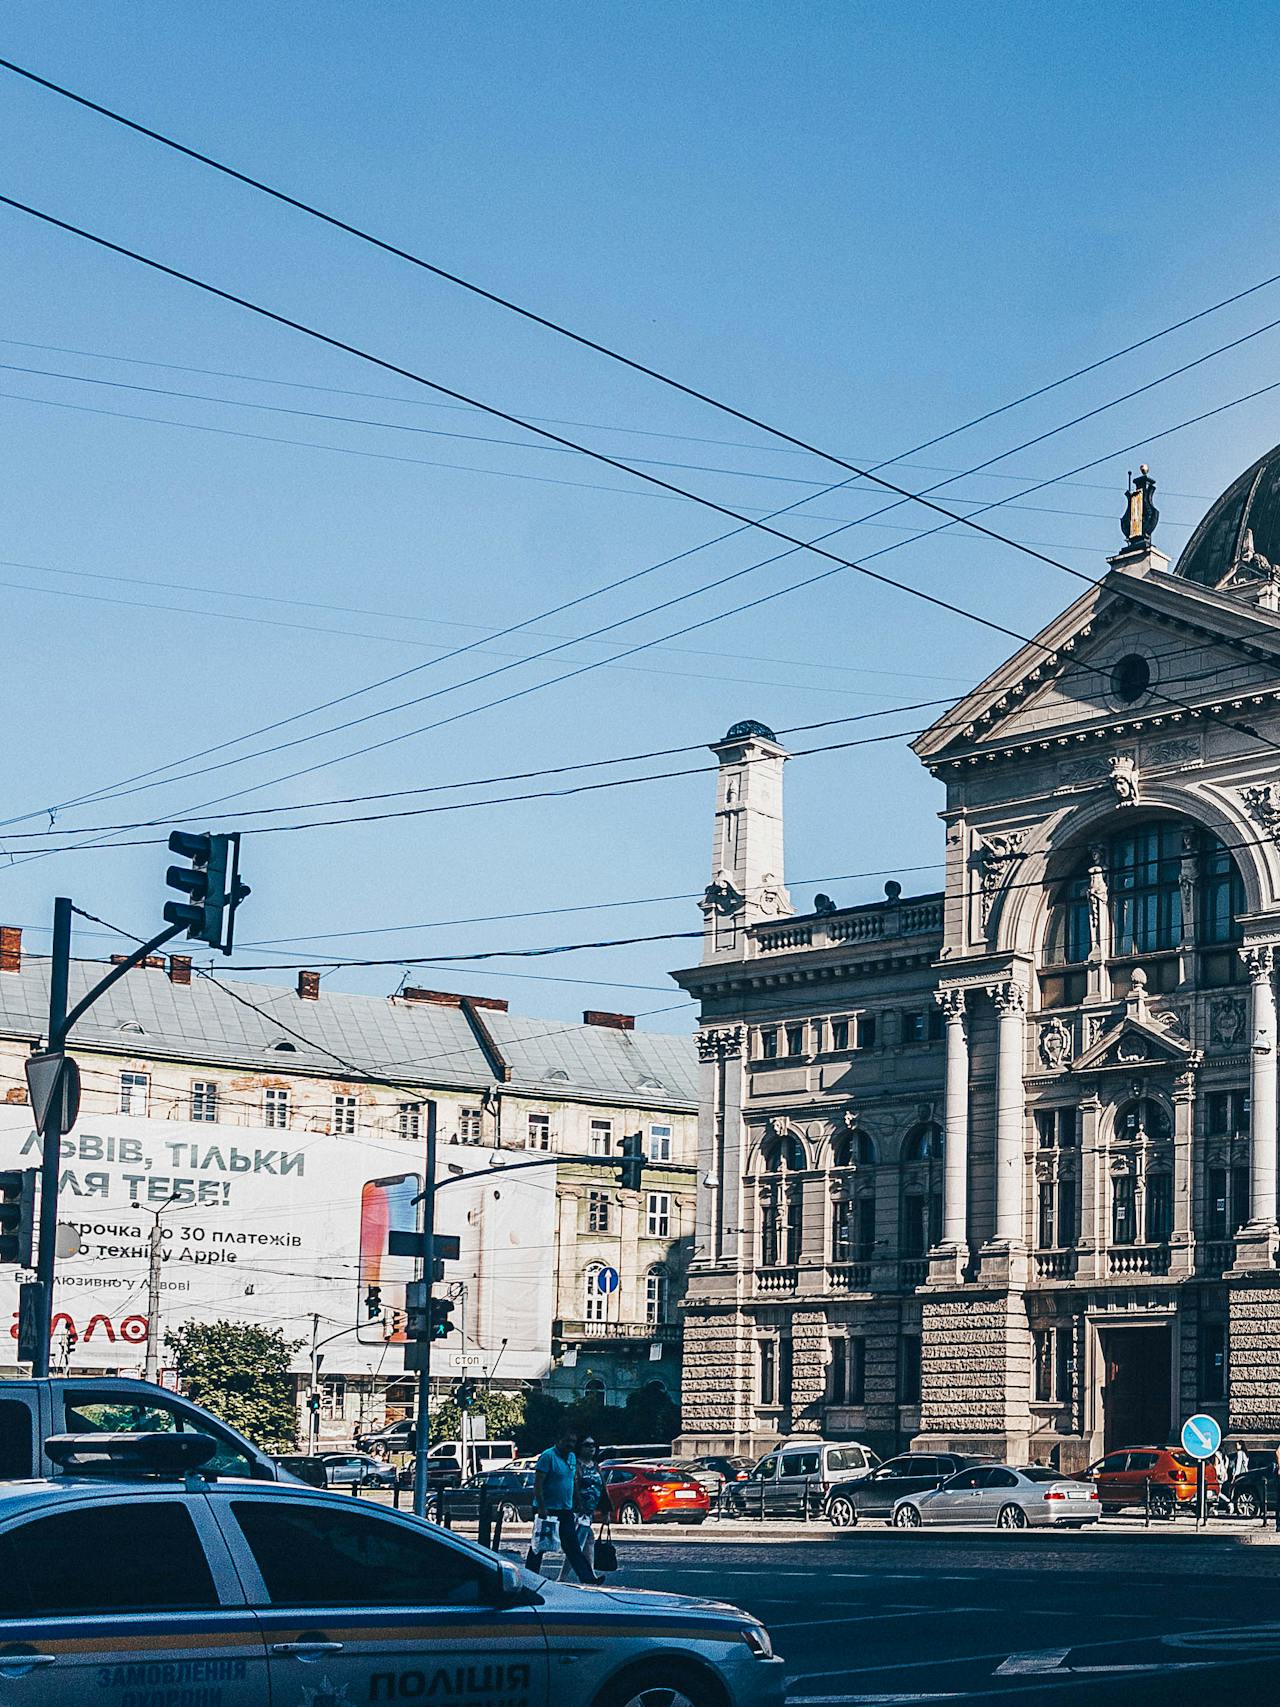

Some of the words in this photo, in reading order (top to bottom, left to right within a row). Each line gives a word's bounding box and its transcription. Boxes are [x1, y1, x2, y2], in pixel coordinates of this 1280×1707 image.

[165, 1141, 305, 1177] ТІЛЬКИ
[37, 1169, 109, 1198] ЛЯ
[122, 1174, 231, 1206] ТЕБЕ!
[181, 1226, 205, 1241] 30
[212, 1231, 302, 1248] платежів
[97, 1243, 172, 1262] техніу
[179, 1246, 237, 1264] Apple
[140, 1279, 190, 1291] Лвові
[97, 1660, 247, 1688] ЗАМОВЛЕННЯ
[368, 1664, 531, 1701] ПОЛІЦІЯ
